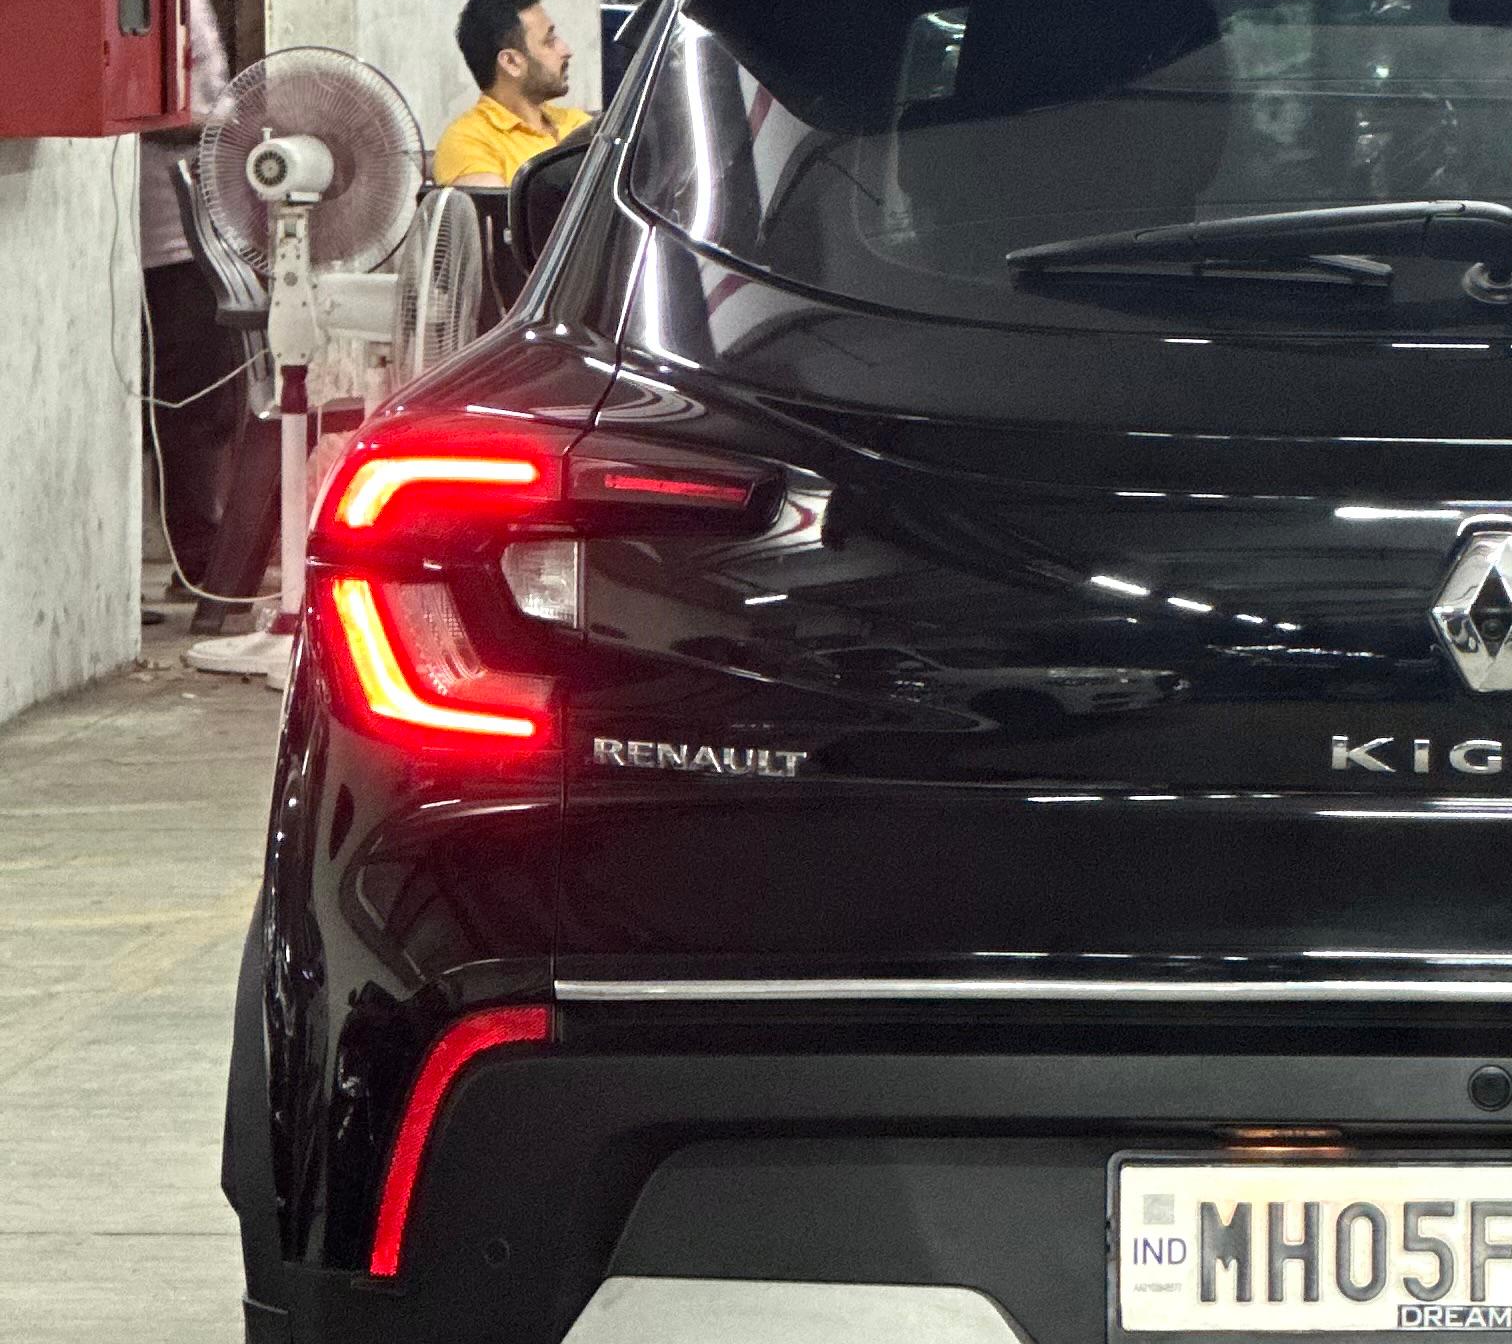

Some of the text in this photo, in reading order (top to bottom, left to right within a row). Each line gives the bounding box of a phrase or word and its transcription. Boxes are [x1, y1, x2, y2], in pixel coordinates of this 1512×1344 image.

[593, 737, 808, 778] RENAULT
[1133, 1237, 1187, 1265] IND
[1401, 1306, 1512, 1329] DREAM
